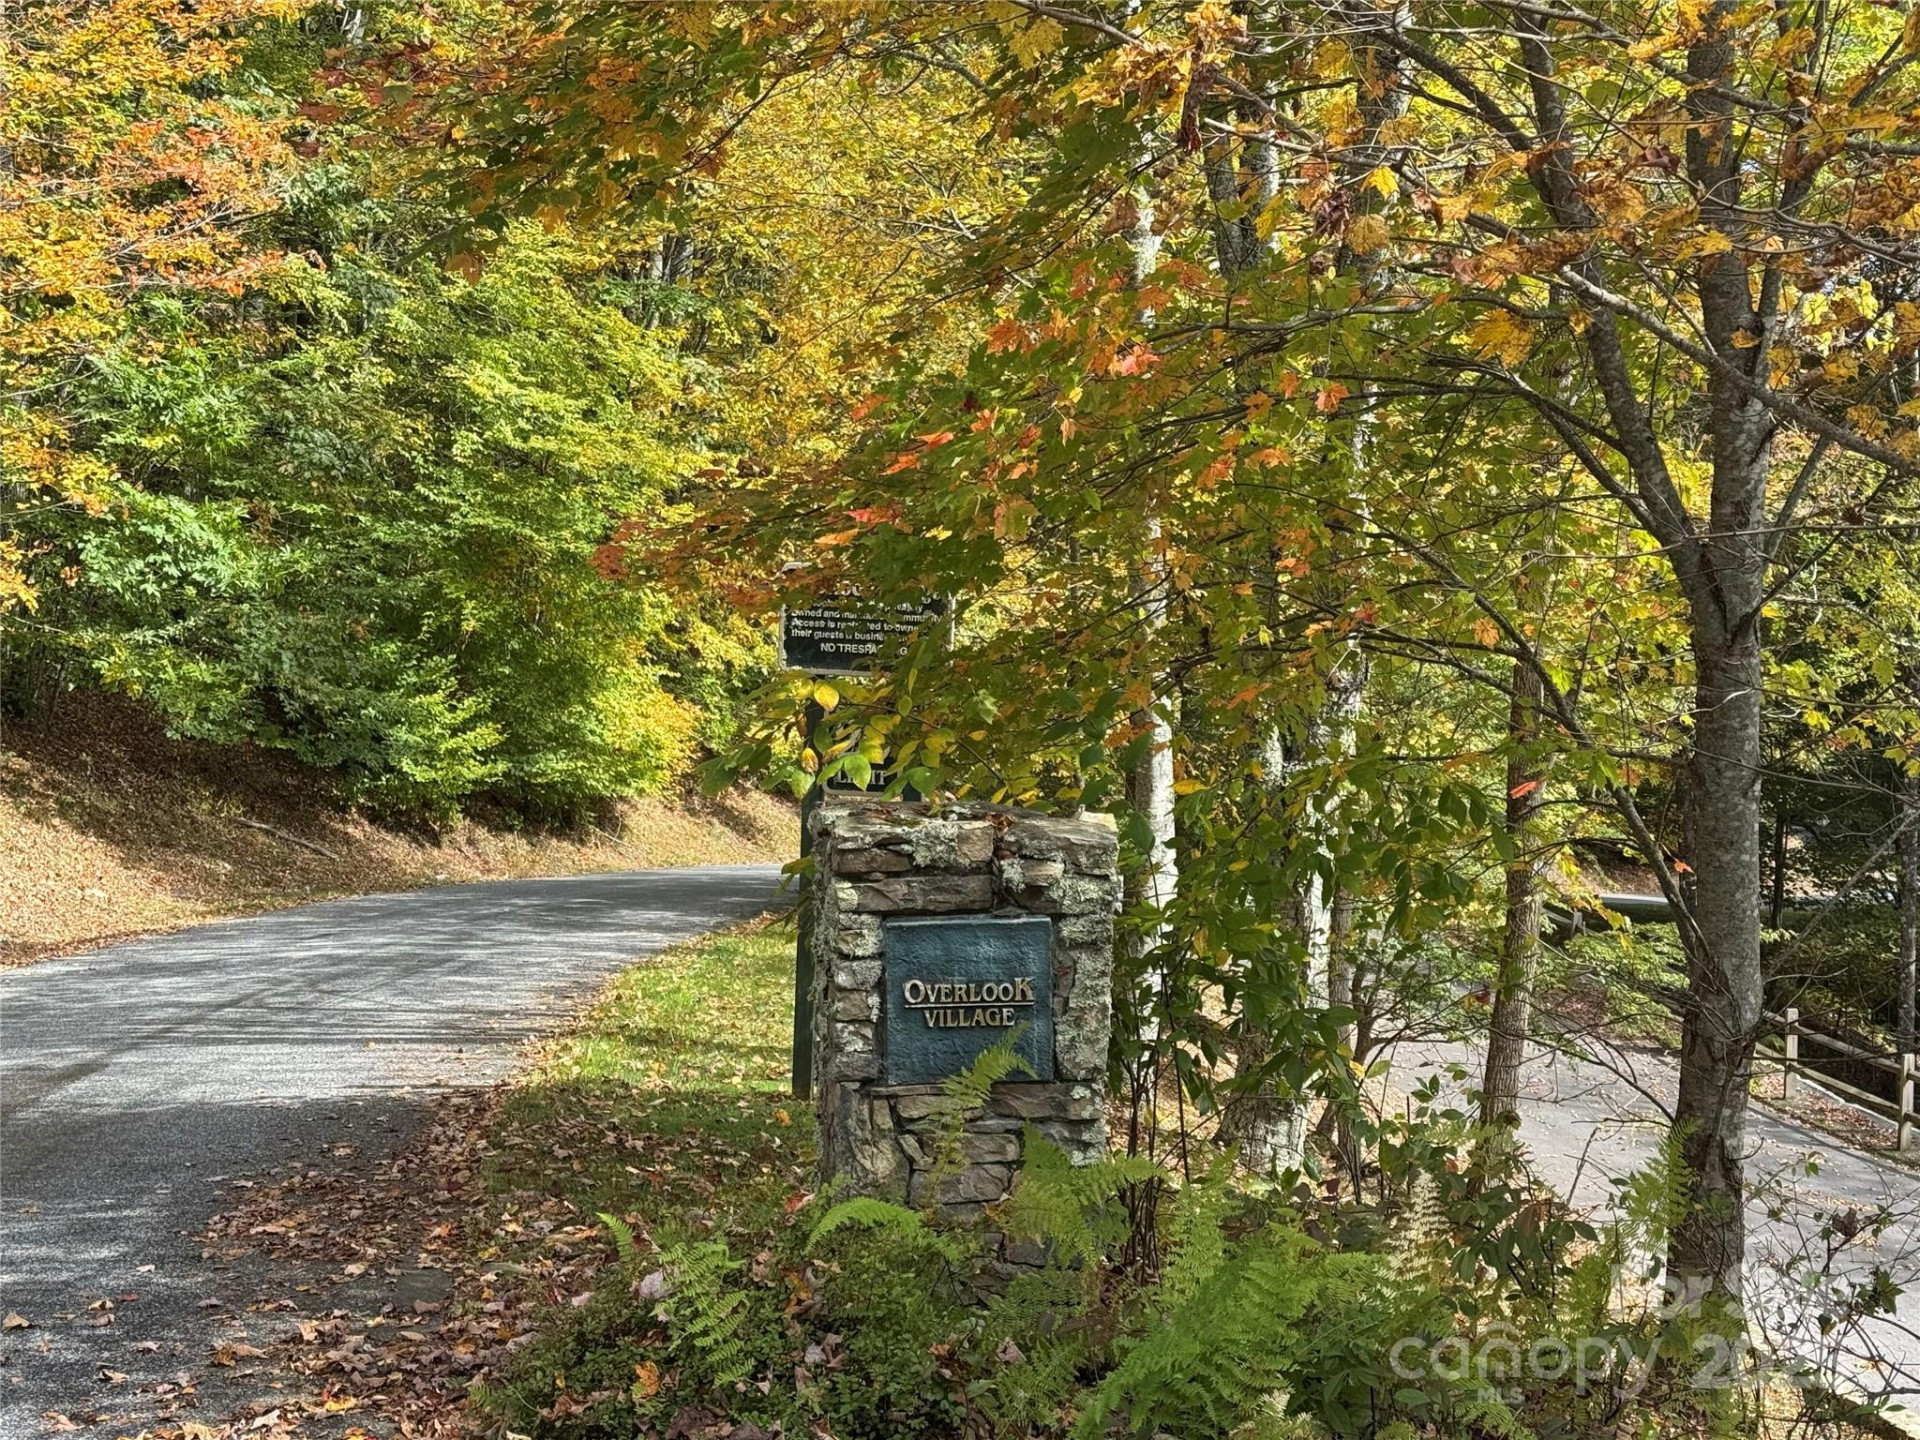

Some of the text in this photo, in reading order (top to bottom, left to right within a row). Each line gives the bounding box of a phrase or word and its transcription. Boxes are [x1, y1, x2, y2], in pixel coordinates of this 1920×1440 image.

[823, 609, 840, 618] and
[791, 618, 826, 628] Access
[827, 620, 836, 628] is
[884, 622, 893, 631] to
[791, 628, 812, 638] their
[813, 630, 844, 640] guests
[820, 642, 908, 655] NO TRESPAG
[836, 769, 886, 785] LIT
[903, 977, 1035, 1004] OVERLOOK
[924, 1007, 1016, 1028] VILLAGE
